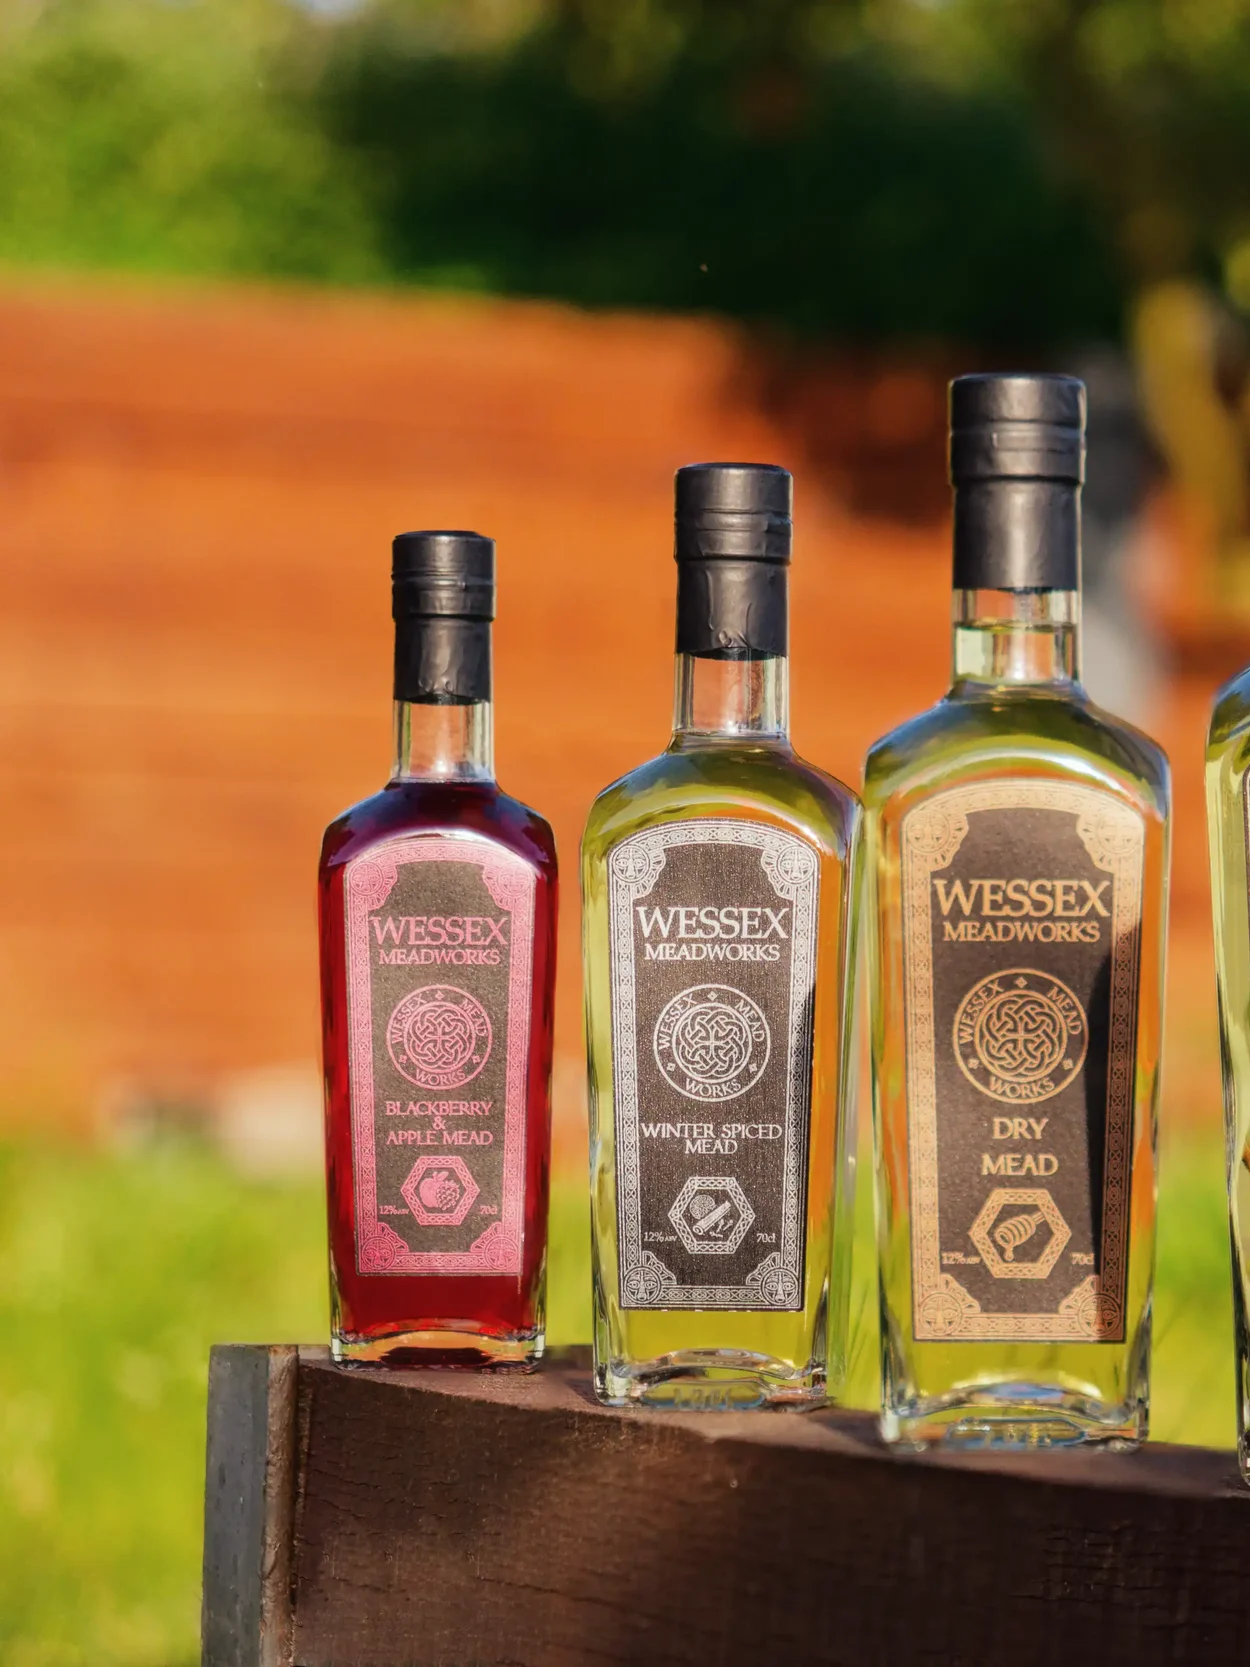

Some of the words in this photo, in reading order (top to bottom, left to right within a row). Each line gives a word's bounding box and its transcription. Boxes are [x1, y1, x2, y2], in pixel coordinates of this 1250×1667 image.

[935, 878, 1111, 917] WESSEX
[369, 916, 508, 945] WESSEX
[636, 906, 789, 939] WESSEX
[943, 921, 1101, 942] MEADWORKS
[378, 949, 500, 965] MEADWORKS
[644, 943, 780, 961] MEADWORKS
[391, 993, 427, 1044] WESSEX
[459, 998, 487, 1037] MEAD
[959, 979, 1004, 1044] WESSEX
[1047, 987, 1082, 1035] MEAD
[658, 993, 698, 1050] WESSEX
[734, 999, 765, 1042] MEAD
[416, 1069, 466, 1086] WORKS
[988, 1076, 1055, 1098] WORKS
[685, 1078, 742, 1097] WORKS
[385, 1101, 494, 1115] BLACKBERRY
[432, 1116, 446, 1130] &
[640, 1122, 716, 1138] WINTER
[721, 1123, 782, 1139] SPICED
[992, 1117, 1049, 1140] DRY
[386, 1131, 439, 1145] APPLE
[442, 1131, 494, 1145] MEAD
[684, 1139, 738, 1154] MEAD
[981, 1153, 1059, 1176] MEAD
[756, 1232, 776, 1243] 70cl
[1071, 1252, 1095, 1266] 70cl
